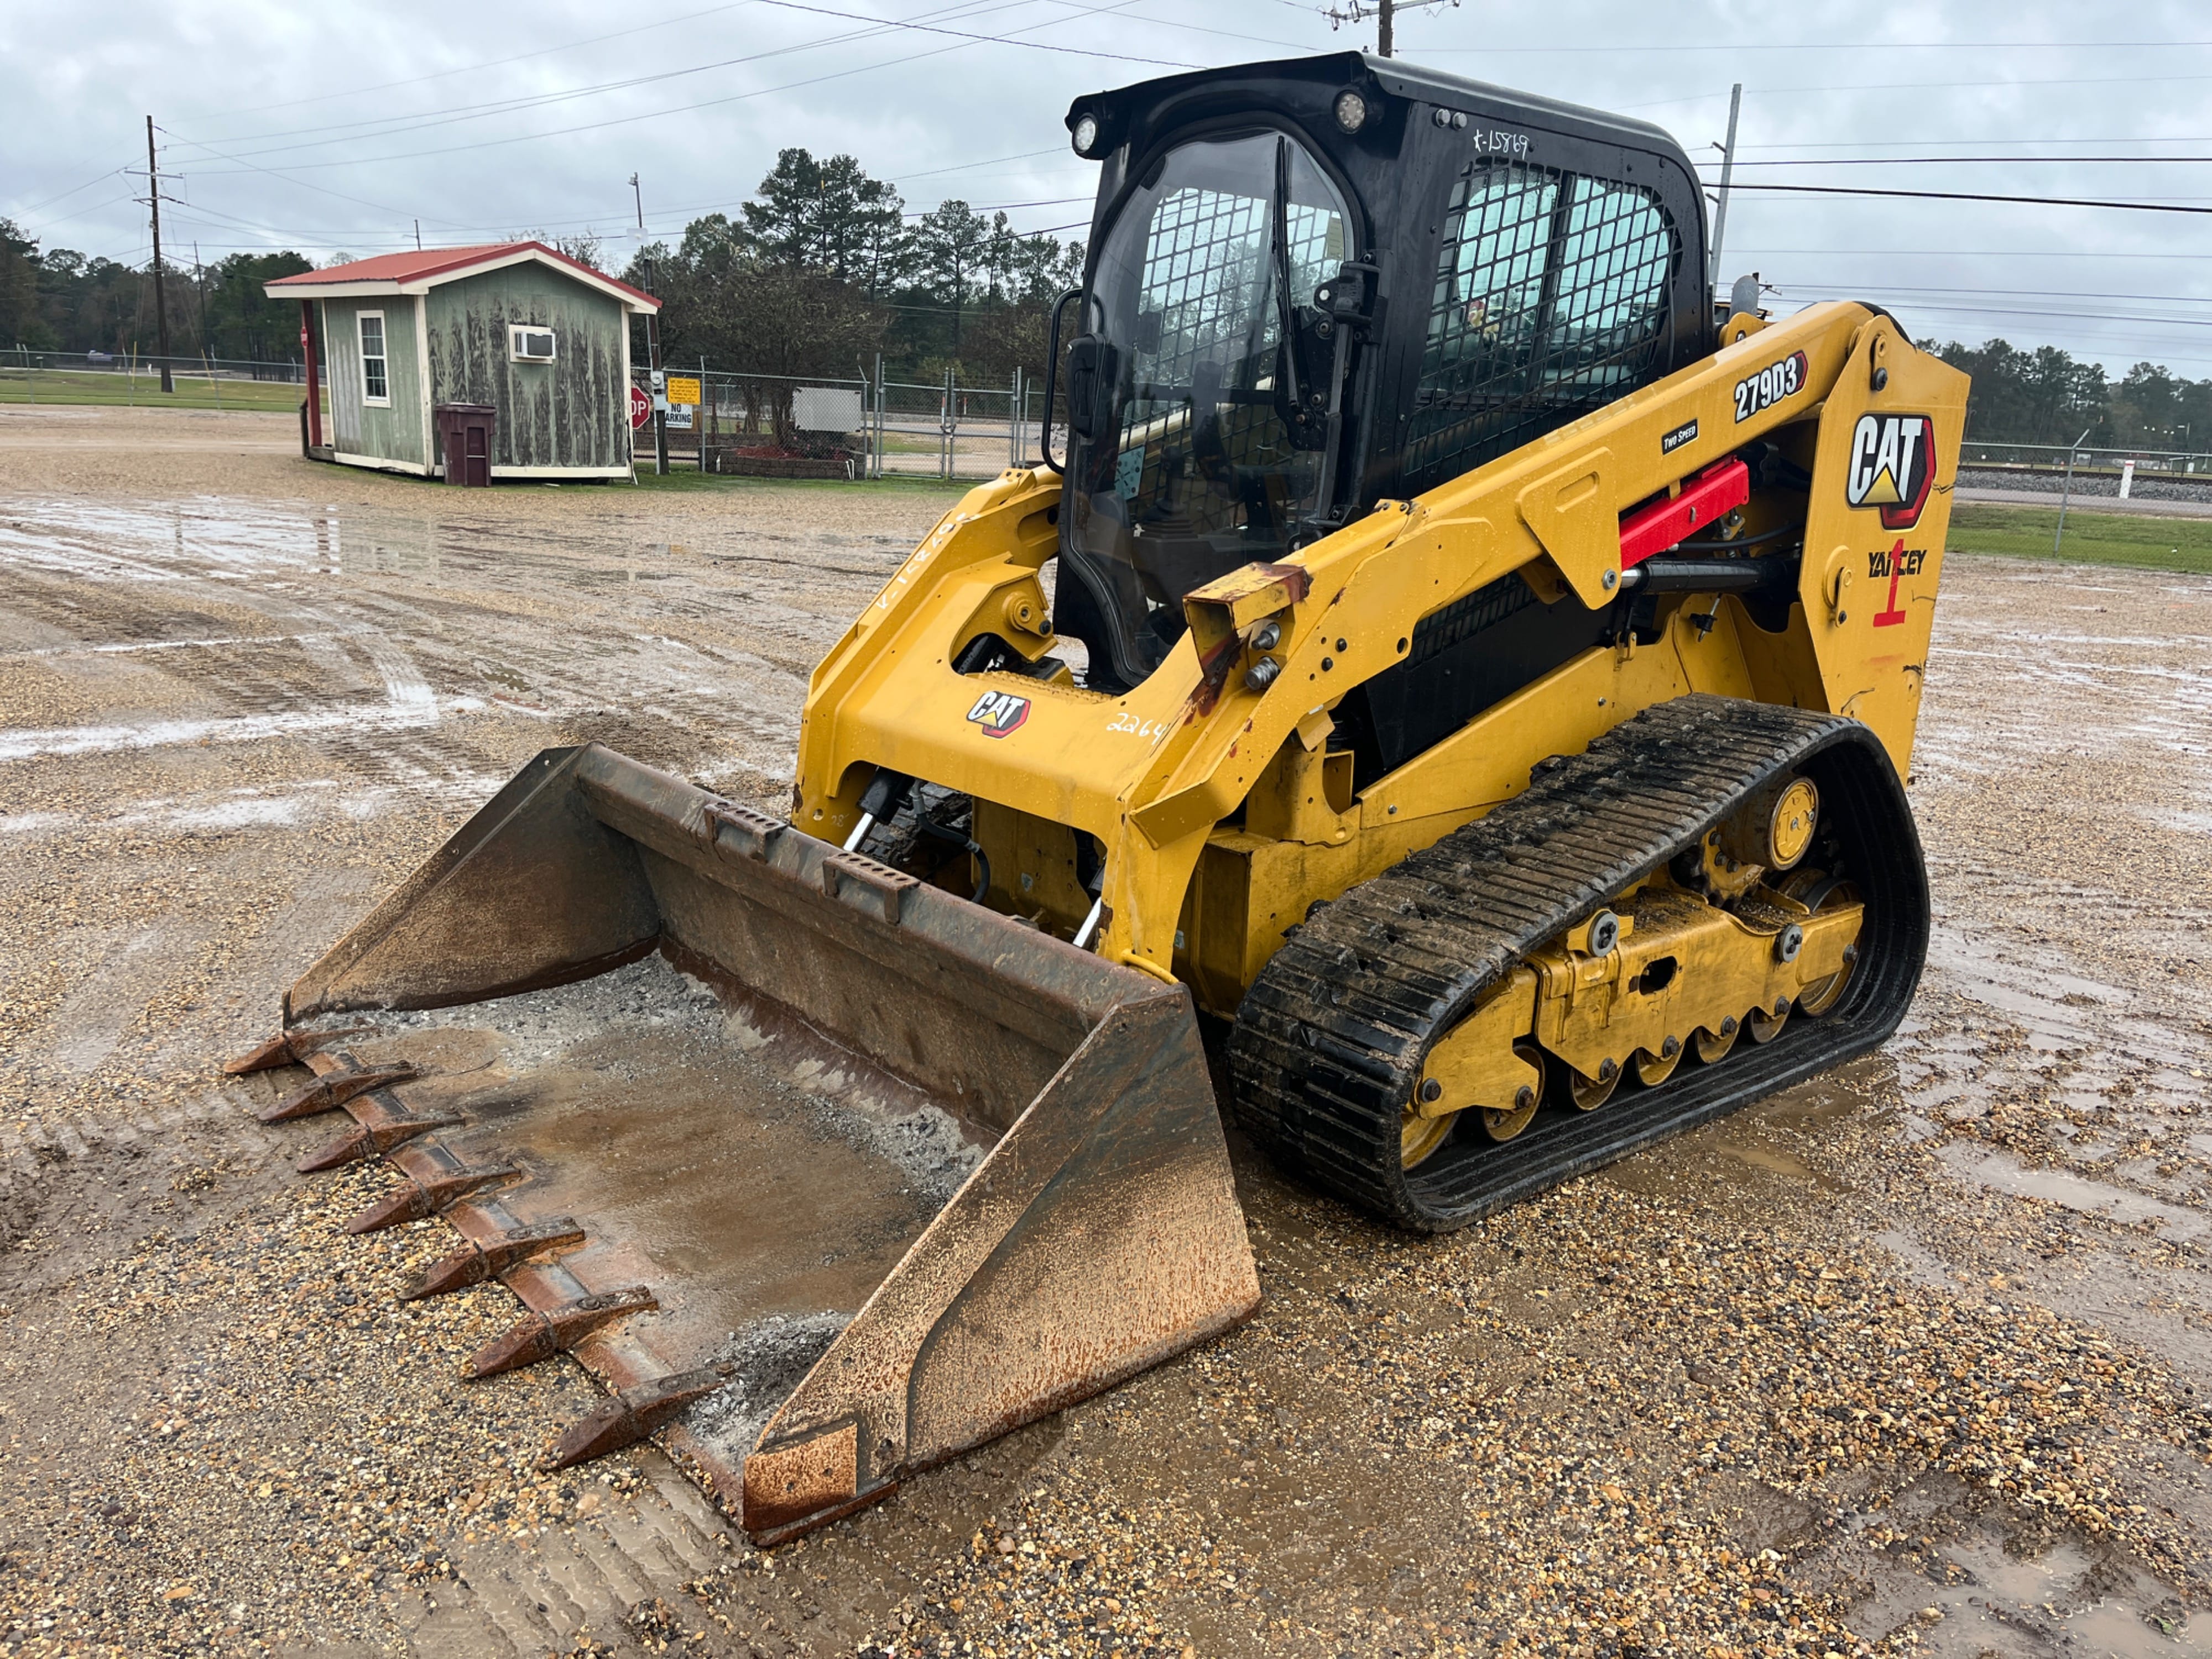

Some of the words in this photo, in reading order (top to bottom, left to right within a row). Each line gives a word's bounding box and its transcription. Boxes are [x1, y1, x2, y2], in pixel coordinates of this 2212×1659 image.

[1735, 357, 1797, 421] 279D3
[632, 400, 646, 416] OP
[666, 413, 691, 423] ARKING
[671, 403, 681, 413] NO
[1848, 416, 1923, 504] CAT
[968, 691, 1026, 728] CAT
[1106, 712, 1168, 745] 2264
